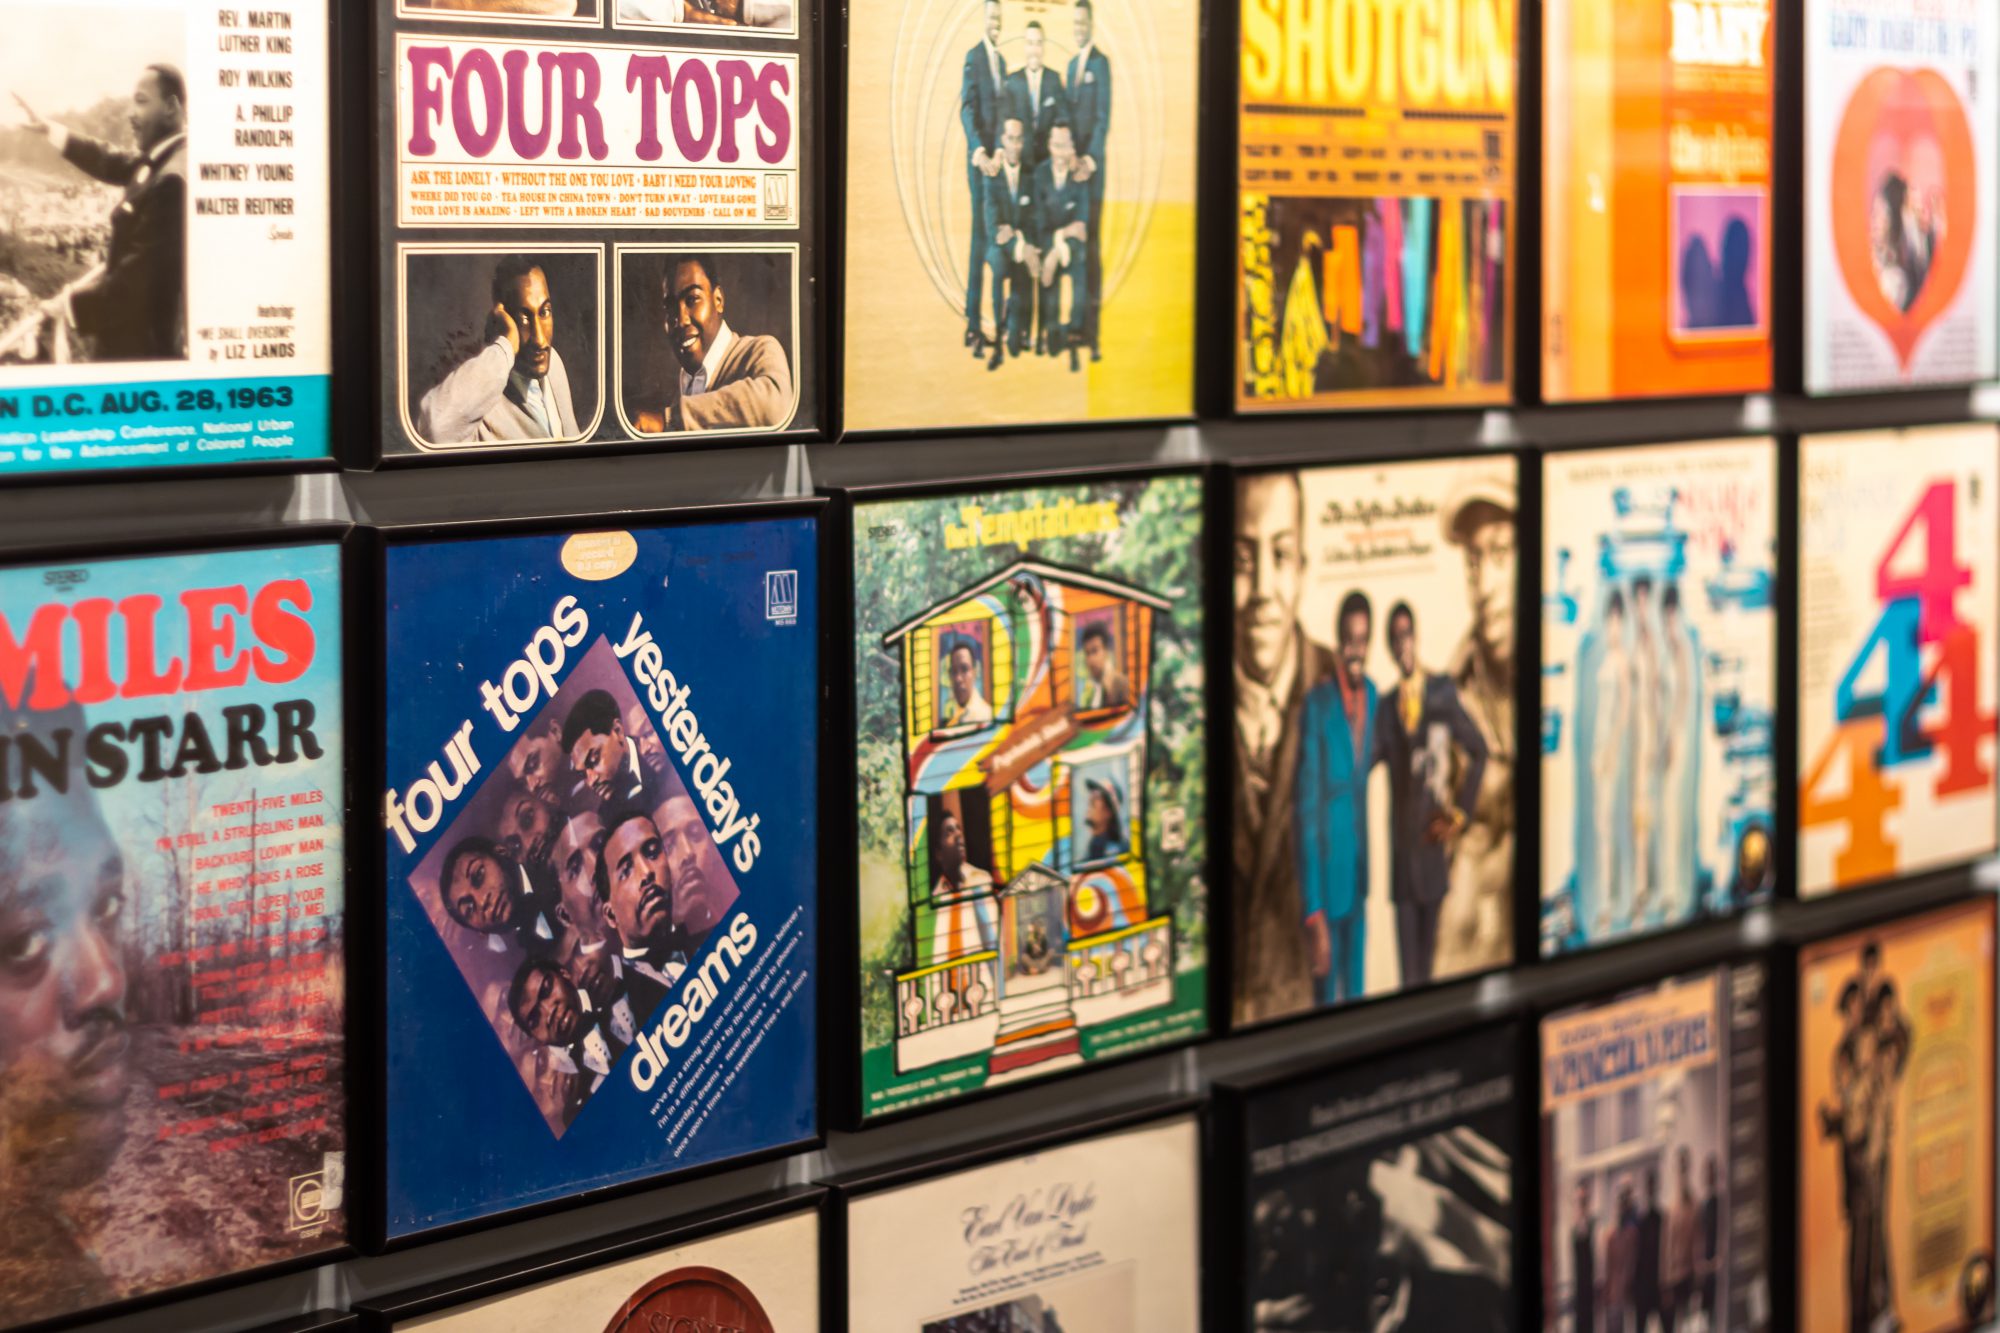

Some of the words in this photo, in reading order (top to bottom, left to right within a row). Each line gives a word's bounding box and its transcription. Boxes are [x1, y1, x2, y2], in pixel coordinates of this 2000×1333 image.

[219, 9, 242, 28] REV.
[248, 10, 292, 29] MARTIN
[218, 34, 260, 53] LUTHER
[266, 35, 292, 54] KING
[1242, 0, 1512, 102] SHOTGUN
[218, 69, 240, 87] ROY
[247, 69, 293, 89] WILKINS
[252, 104, 293, 123] PHILLIP
[407, 45, 609, 160] FOUR
[626, 53, 791, 164] TOPS
[235, 128, 293, 147] RANDOLPH
[199, 163, 249, 181] WHITNEY
[256, 163, 294, 181] YOUNG
[411, 170, 430, 185] ASK
[434, 171, 453, 185] THE
[455, 171, 492, 186] LONELY
[502, 172, 546, 187] WITHOUT
[550, 172, 568, 187] THE
[570, 173, 588, 187] ONE
[590, 173, 608, 187] YOU
[611, 173, 634, 188] LOVE
[643, 174, 667, 188] BABY
[669, 174, 673, 187] I
[675, 174, 697, 189] NEED
[700, 175, 723, 189] YOUR
[725, 175, 757, 189] LOVING
[195, 197, 239, 215] WALTER
[245, 197, 294, 215] REUTHER
[410, 190, 442, 202] WHERE
[444, 191, 459, 202] DID
[461, 191, 478, 202] YOU
[480, 191, 492, 202] GO
[501, 192, 517, 203] TEA
[519, 192, 546, 203] HOUSE
[549, 192, 557, 203] IN
[559, 192, 584, 203] CHINA
[586, 193, 611, 203] TOWN
[619, 193, 643, 204] DON'T
[645, 193, 665, 204] TURN
[667, 194, 691, 204] AWAY
[699, 194, 718, 205] LOVE
[411, 205, 435, 216] YOUR
[438, 206, 460, 216] LOVE
[463, 206, 471, 216] IS
[473, 206, 511, 217] AMAZING
[520, 206, 540, 217] LEFT
[543, 206, 564, 217] WITH
[567, 206, 573, 217] A
[575, 206, 608, 217] BROKEN
[610, 207, 636, 217] HEART
[645, 207, 660, 217] SAD
[663, 207, 705, 218] SOUVENIRS
[713, 208, 731, 218] CALL
[733, 208, 744, 218] ON
[747, 208, 757, 218] ME
[226, 343, 246, 359] LIZ
[253, 342, 295, 359] LANDS
[32, 392, 93, 417] D.C.
[101, 390, 169, 414] AUG.
[203, 420, 253, 434] National
[258, 419, 295, 431] Urban
[196, 437, 246, 451] Colored
[252, 434, 294, 448] People
[960, 496, 1120, 552] Temptations
[1876, 478, 1973, 643] 4
[0, 578, 316, 712] MILES
[1835, 595, 1937, 767] 4
[385, 718, 482, 854] four
[480, 595, 589, 732] tops
[1900, 622, 1998, 801] 4
[85, 698, 324, 789] STARR
[613, 611, 761, 873] yesterday's
[212, 795, 286, 818] TWENTY-FIVE
[290, 789, 323, 806] MILES
[1800, 714, 1904, 890] 4
[212, 830, 220, 842] A
[223, 818, 294, 842] STRUGGLING
[298, 814, 324, 829] MAN
[195, 849, 256, 871] BACKYARD
[299, 838, 324, 853] MAN
[197, 880, 212, 896] HE
[217, 876, 243, 891] WHO
[284, 868, 292, 881] A
[296, 862, 324, 879] ROSE
[295, 887, 325, 903] YOUR
[304, 902, 324, 916] ME)
[630, 912, 757, 1092] dreams
[650, 1092, 668, 1115] we've
[667, 1077, 678, 1094] got
[677, 1071, 683, 1079] a
[682, 1045, 703, 1072] strong
[700, 1028, 714, 1046] love
[723, 1001, 734, 1016] our
[749, 940, 777, 979] daydream
[775, 911, 798, 941] believer
[667, 1105, 676, 1115] in
[675, 1098, 681, 1106] a
[679, 1063, 706, 1099] different
[704, 1040, 722, 1065] world
[724, 1025, 734, 1037] by
[732, 1011, 744, 1025] the
[742, 993, 757, 1012] time
[759, 974, 770, 991] get
[768, 965, 777, 975] to
[666, 1099, 699, 1145] yesterday's
[697, 1070, 720, 1100] dreams
[725, 1038, 742, 1061] never
[740, 1026, 751, 1039] my
[749, 1008, 763, 1027] love
[769, 976, 787, 999] sunny
[673, 1137, 689, 1158] once
[687, 1116, 704, 1138] upon
[702, 1110, 709, 1118] a
[706, 1091, 722, 1111] time
[724, 1071, 736, 1086] the
[734, 1029, 765, 1073] sweetheart
[763, 1013, 777, 1030] tree
[780, 990, 793, 1008] and
[791, 970, 808, 992] more
